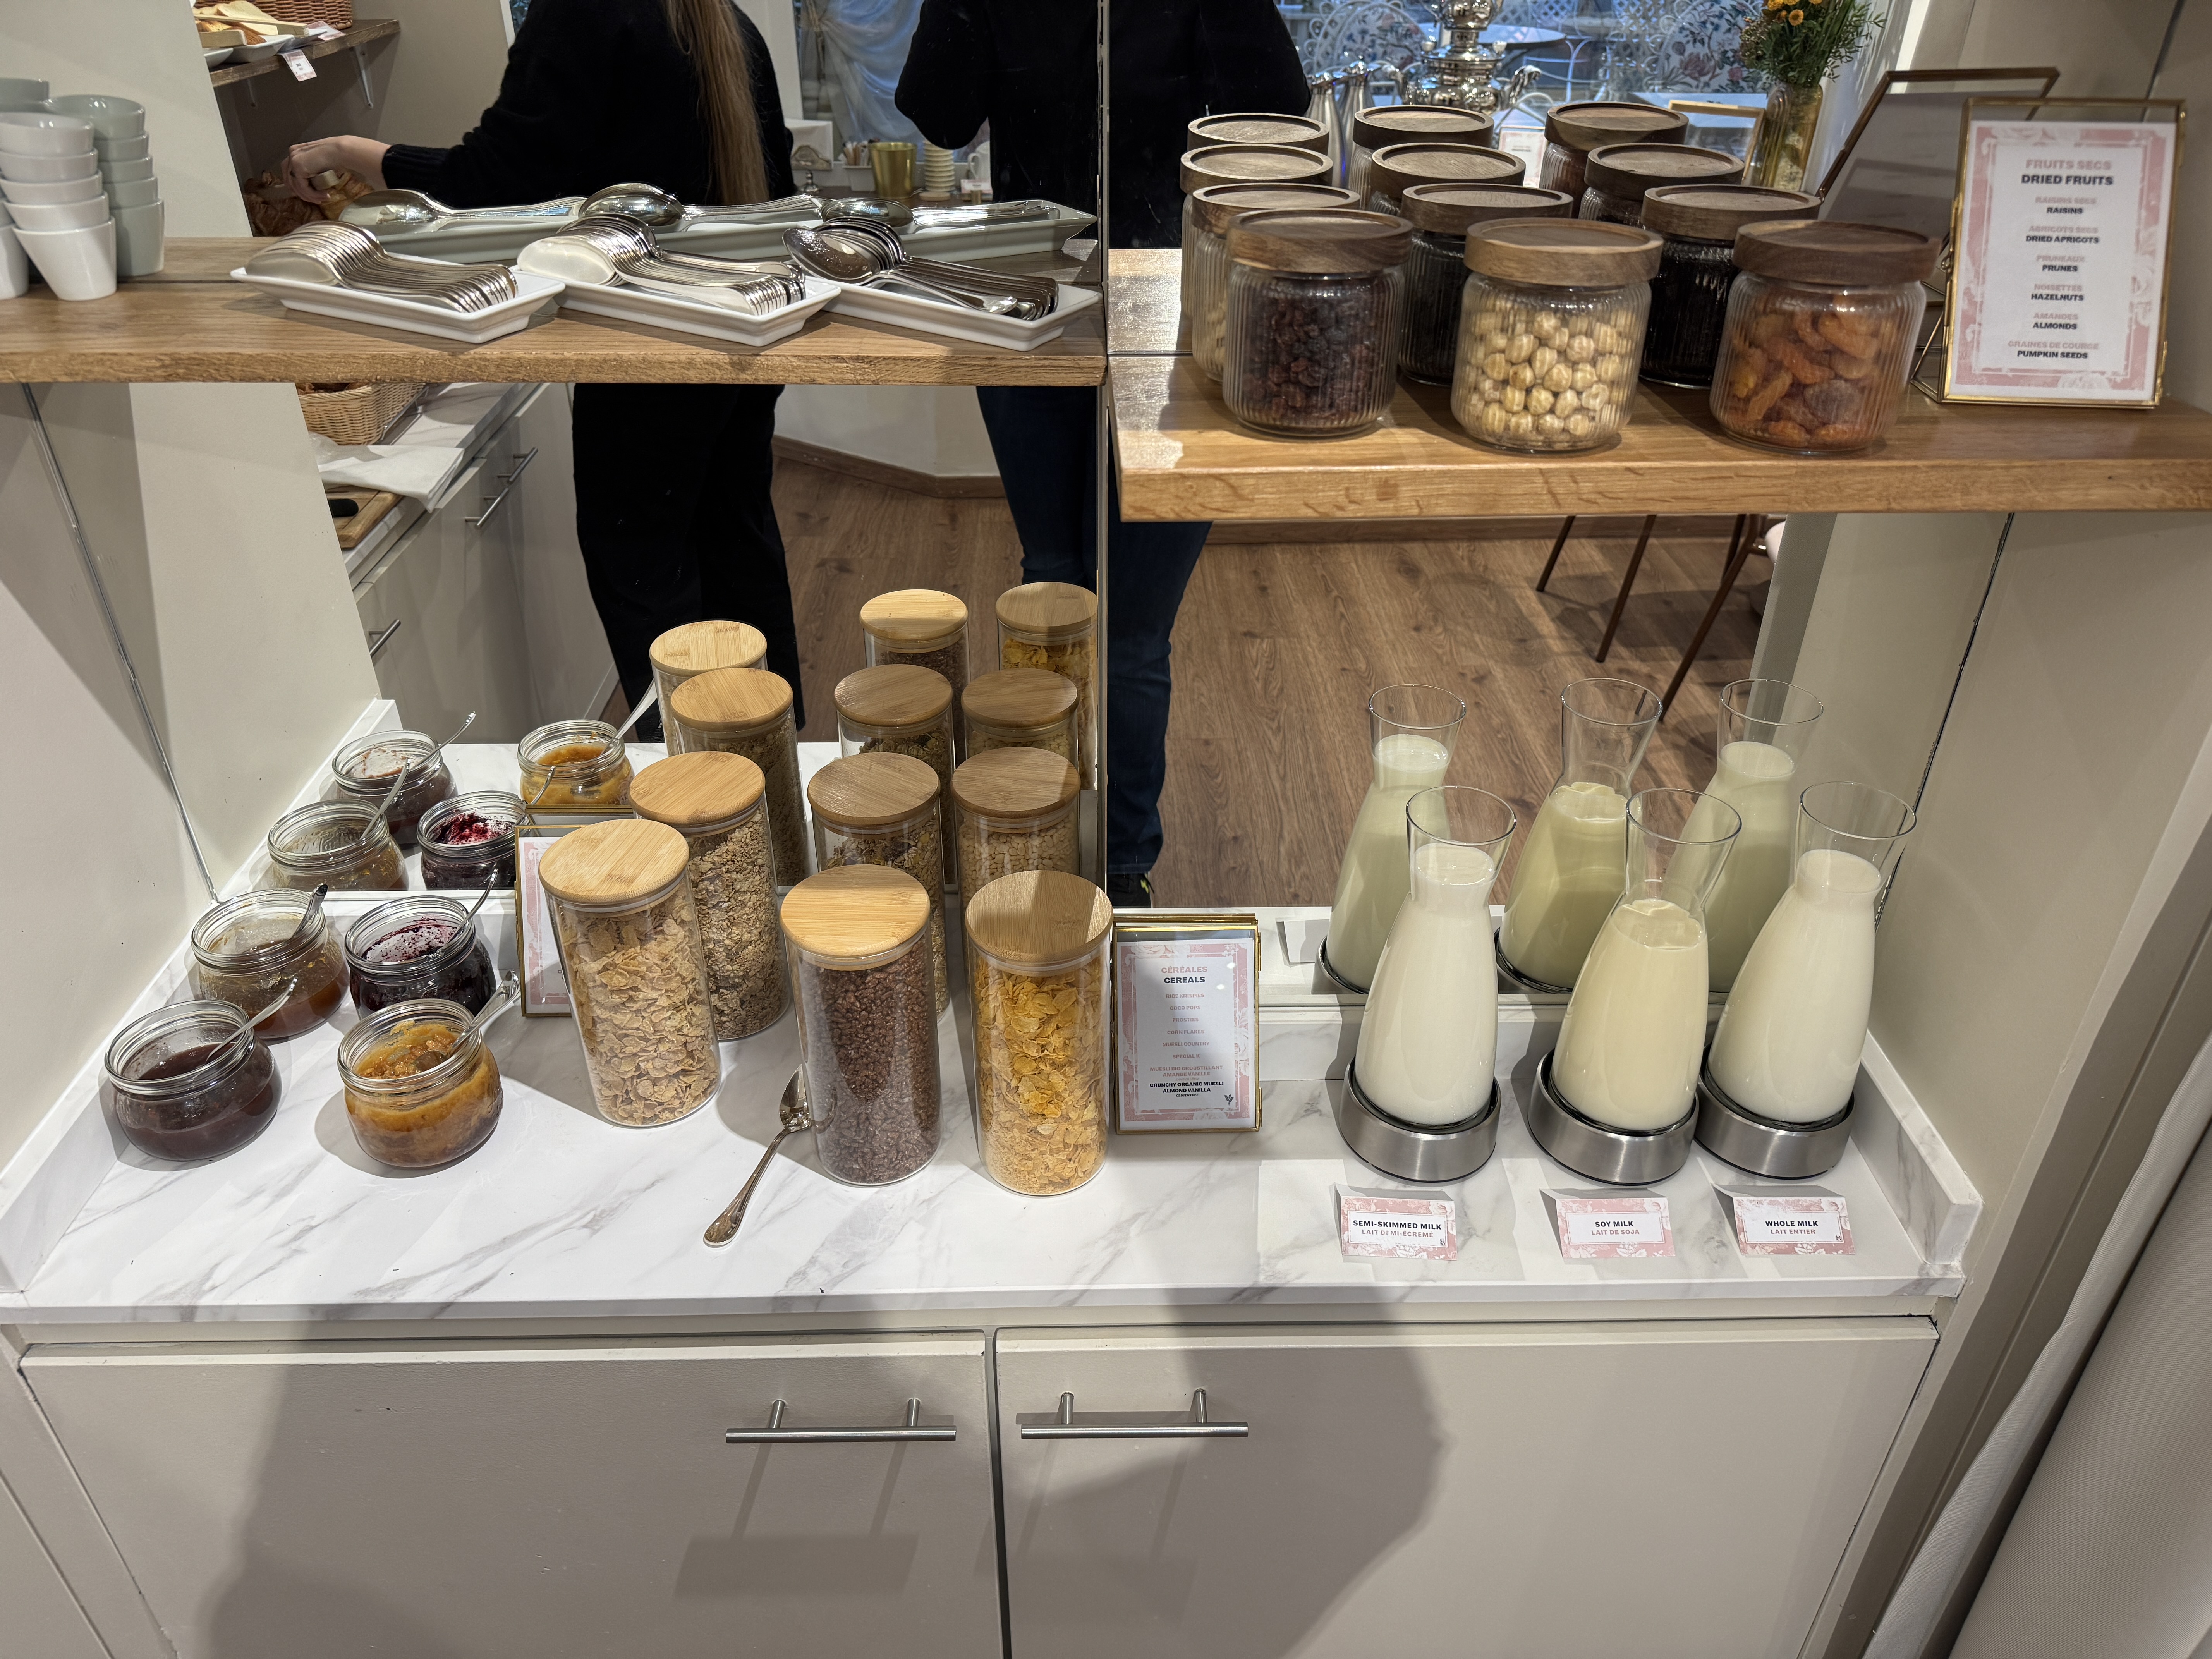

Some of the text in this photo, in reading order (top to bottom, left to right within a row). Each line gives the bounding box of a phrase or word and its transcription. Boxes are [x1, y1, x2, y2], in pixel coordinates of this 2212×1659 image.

[2026, 160, 2111, 170] FRUITS SECS
[2021, 175, 2113, 185] DRIED FRUITS
[2034, 284, 2082, 292] NOISETTES
[1353, 1220, 1417, 1228] SEMI-SKIMMED
